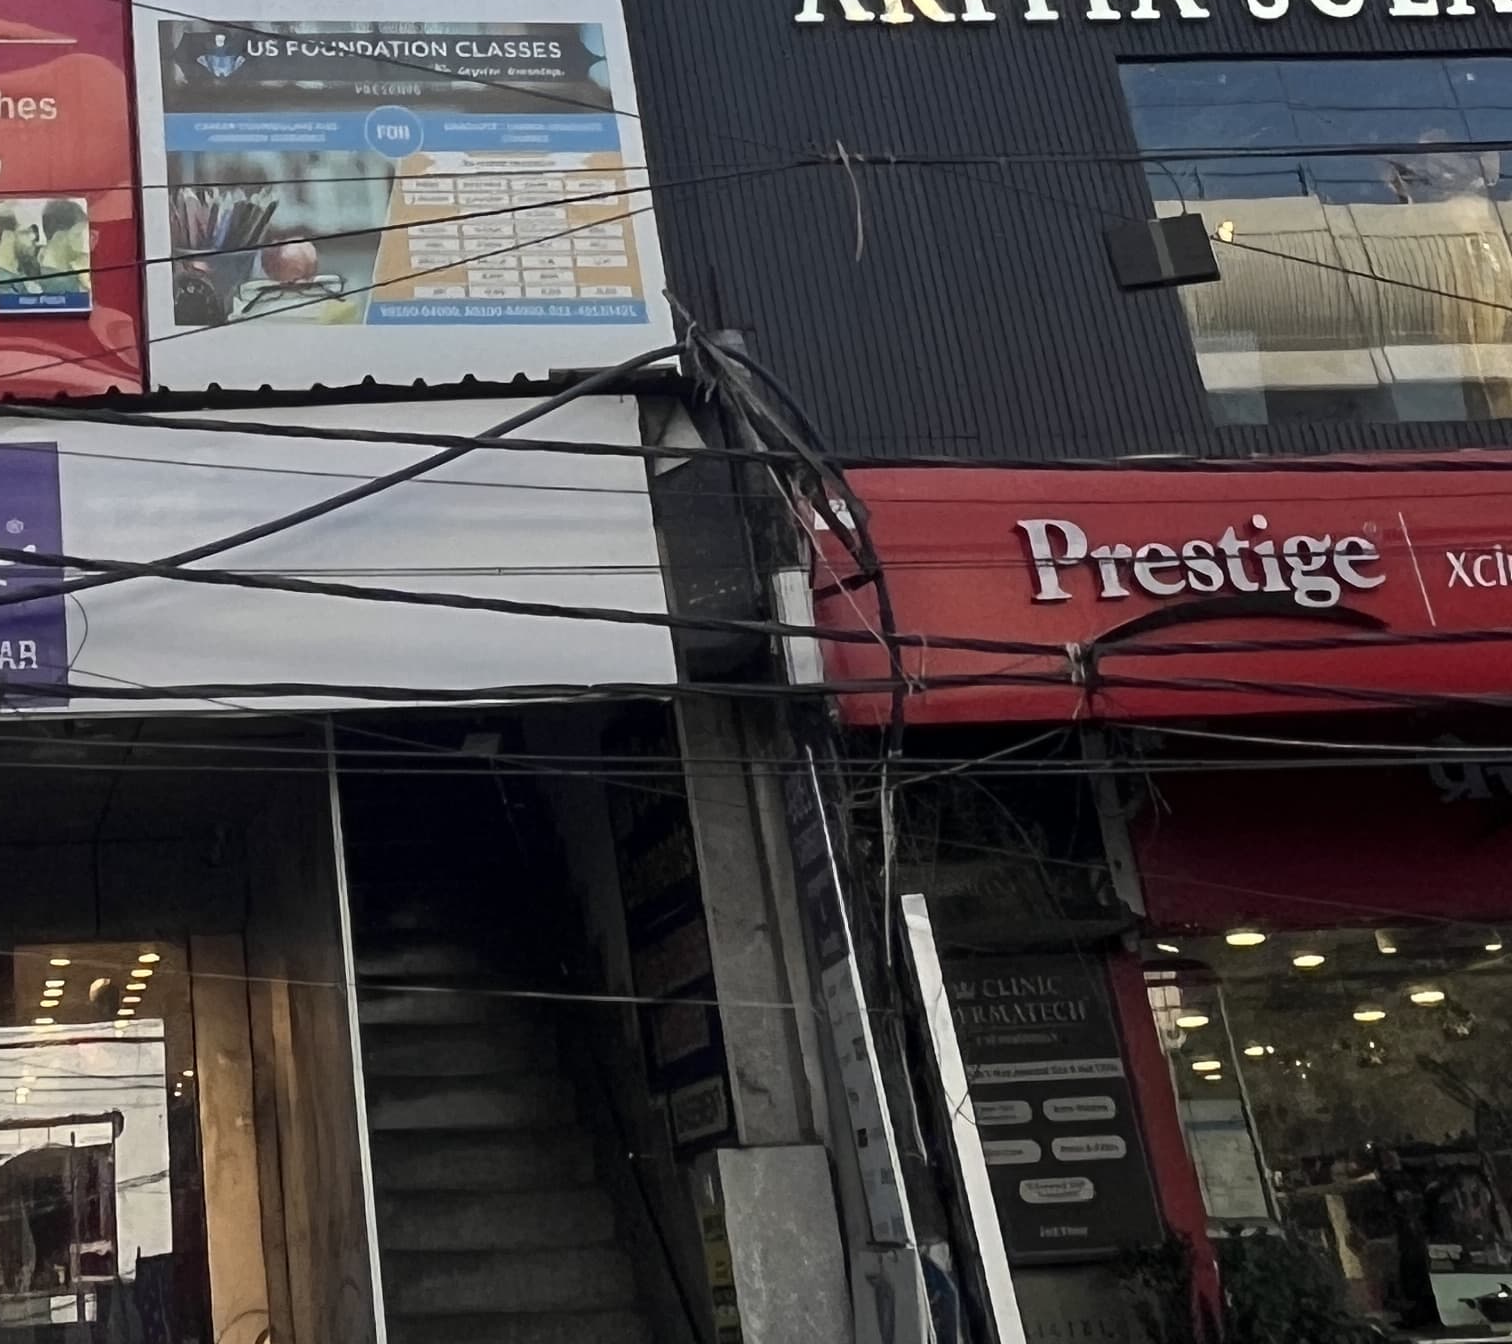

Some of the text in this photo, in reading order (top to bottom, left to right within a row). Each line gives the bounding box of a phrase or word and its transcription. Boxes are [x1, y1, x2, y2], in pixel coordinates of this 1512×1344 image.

[247, 38, 562, 60] US FOUNDATION CLASSES
[1016, 514, 1387, 608] Prestige
[983, 975, 1058, 998] CLINIC
